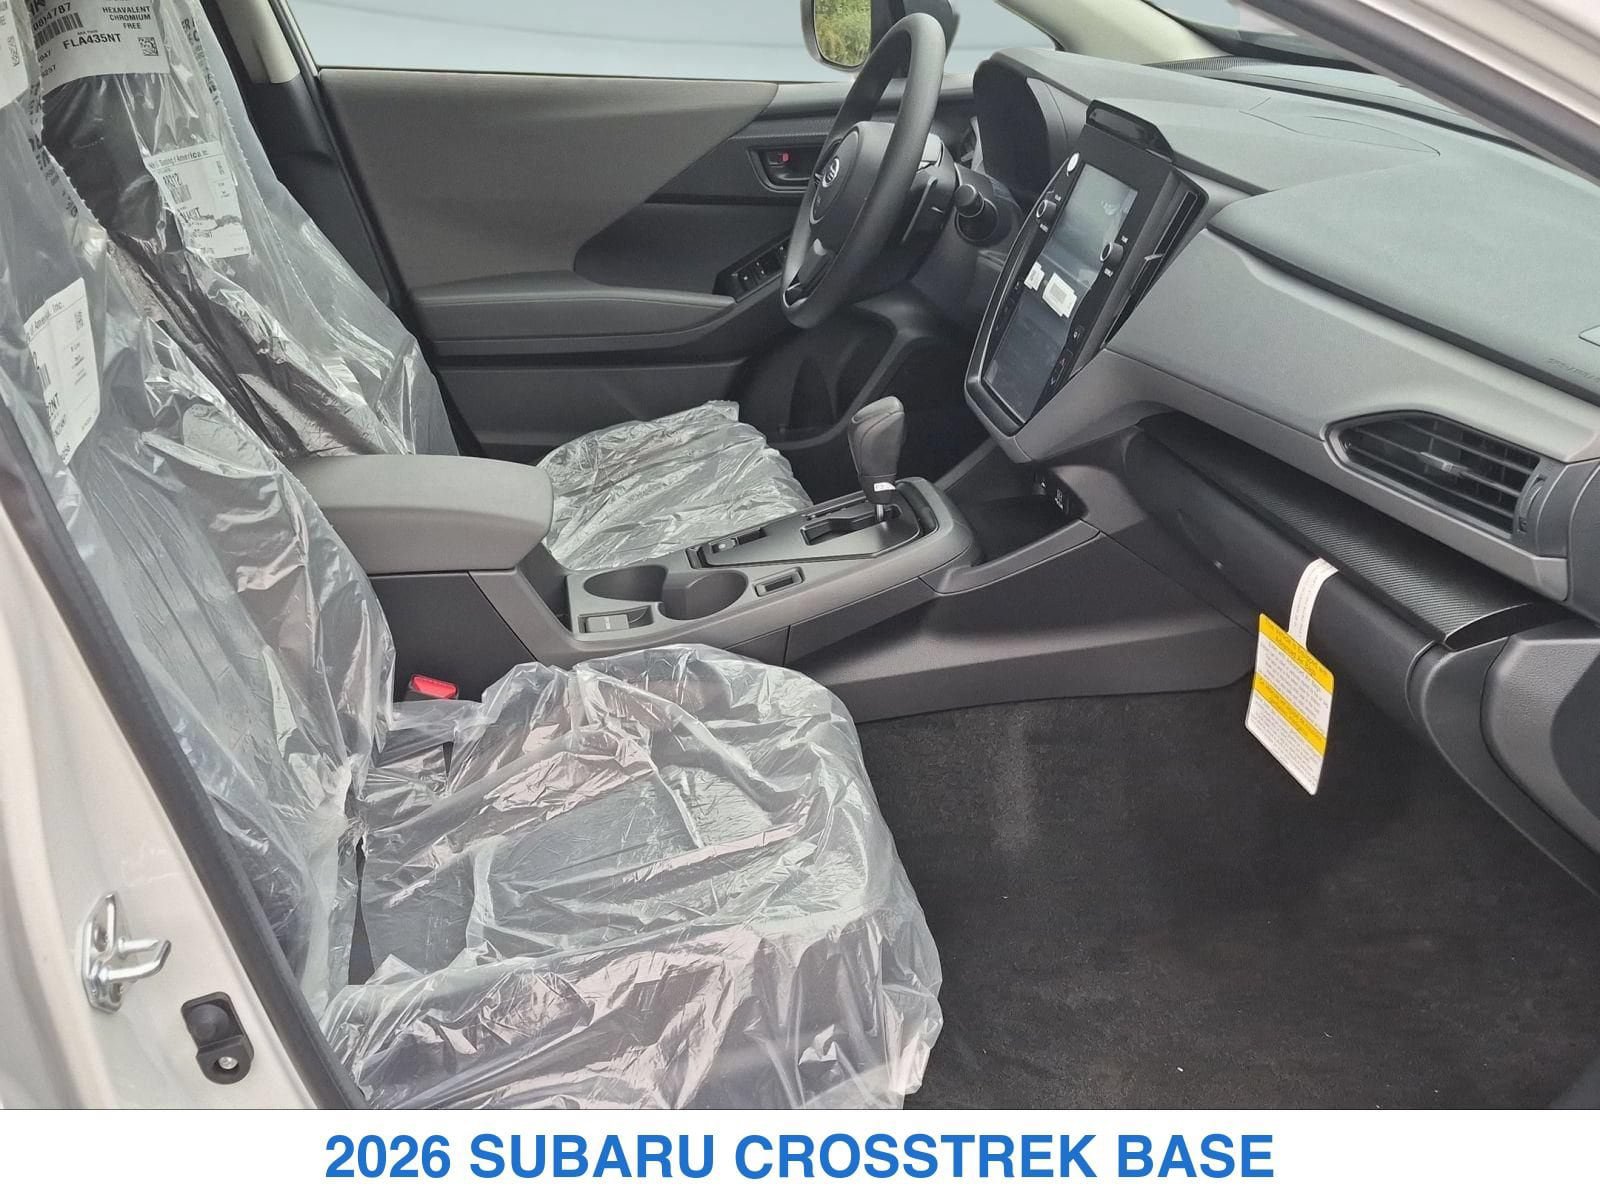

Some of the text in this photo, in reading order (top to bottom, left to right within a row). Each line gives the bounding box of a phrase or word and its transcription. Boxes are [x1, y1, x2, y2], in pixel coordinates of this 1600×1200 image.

[102, 6, 151, 14] HEXAVALENT
[122, 22, 142, 30] FREE
[62, 33, 121, 50] FLA435NT
